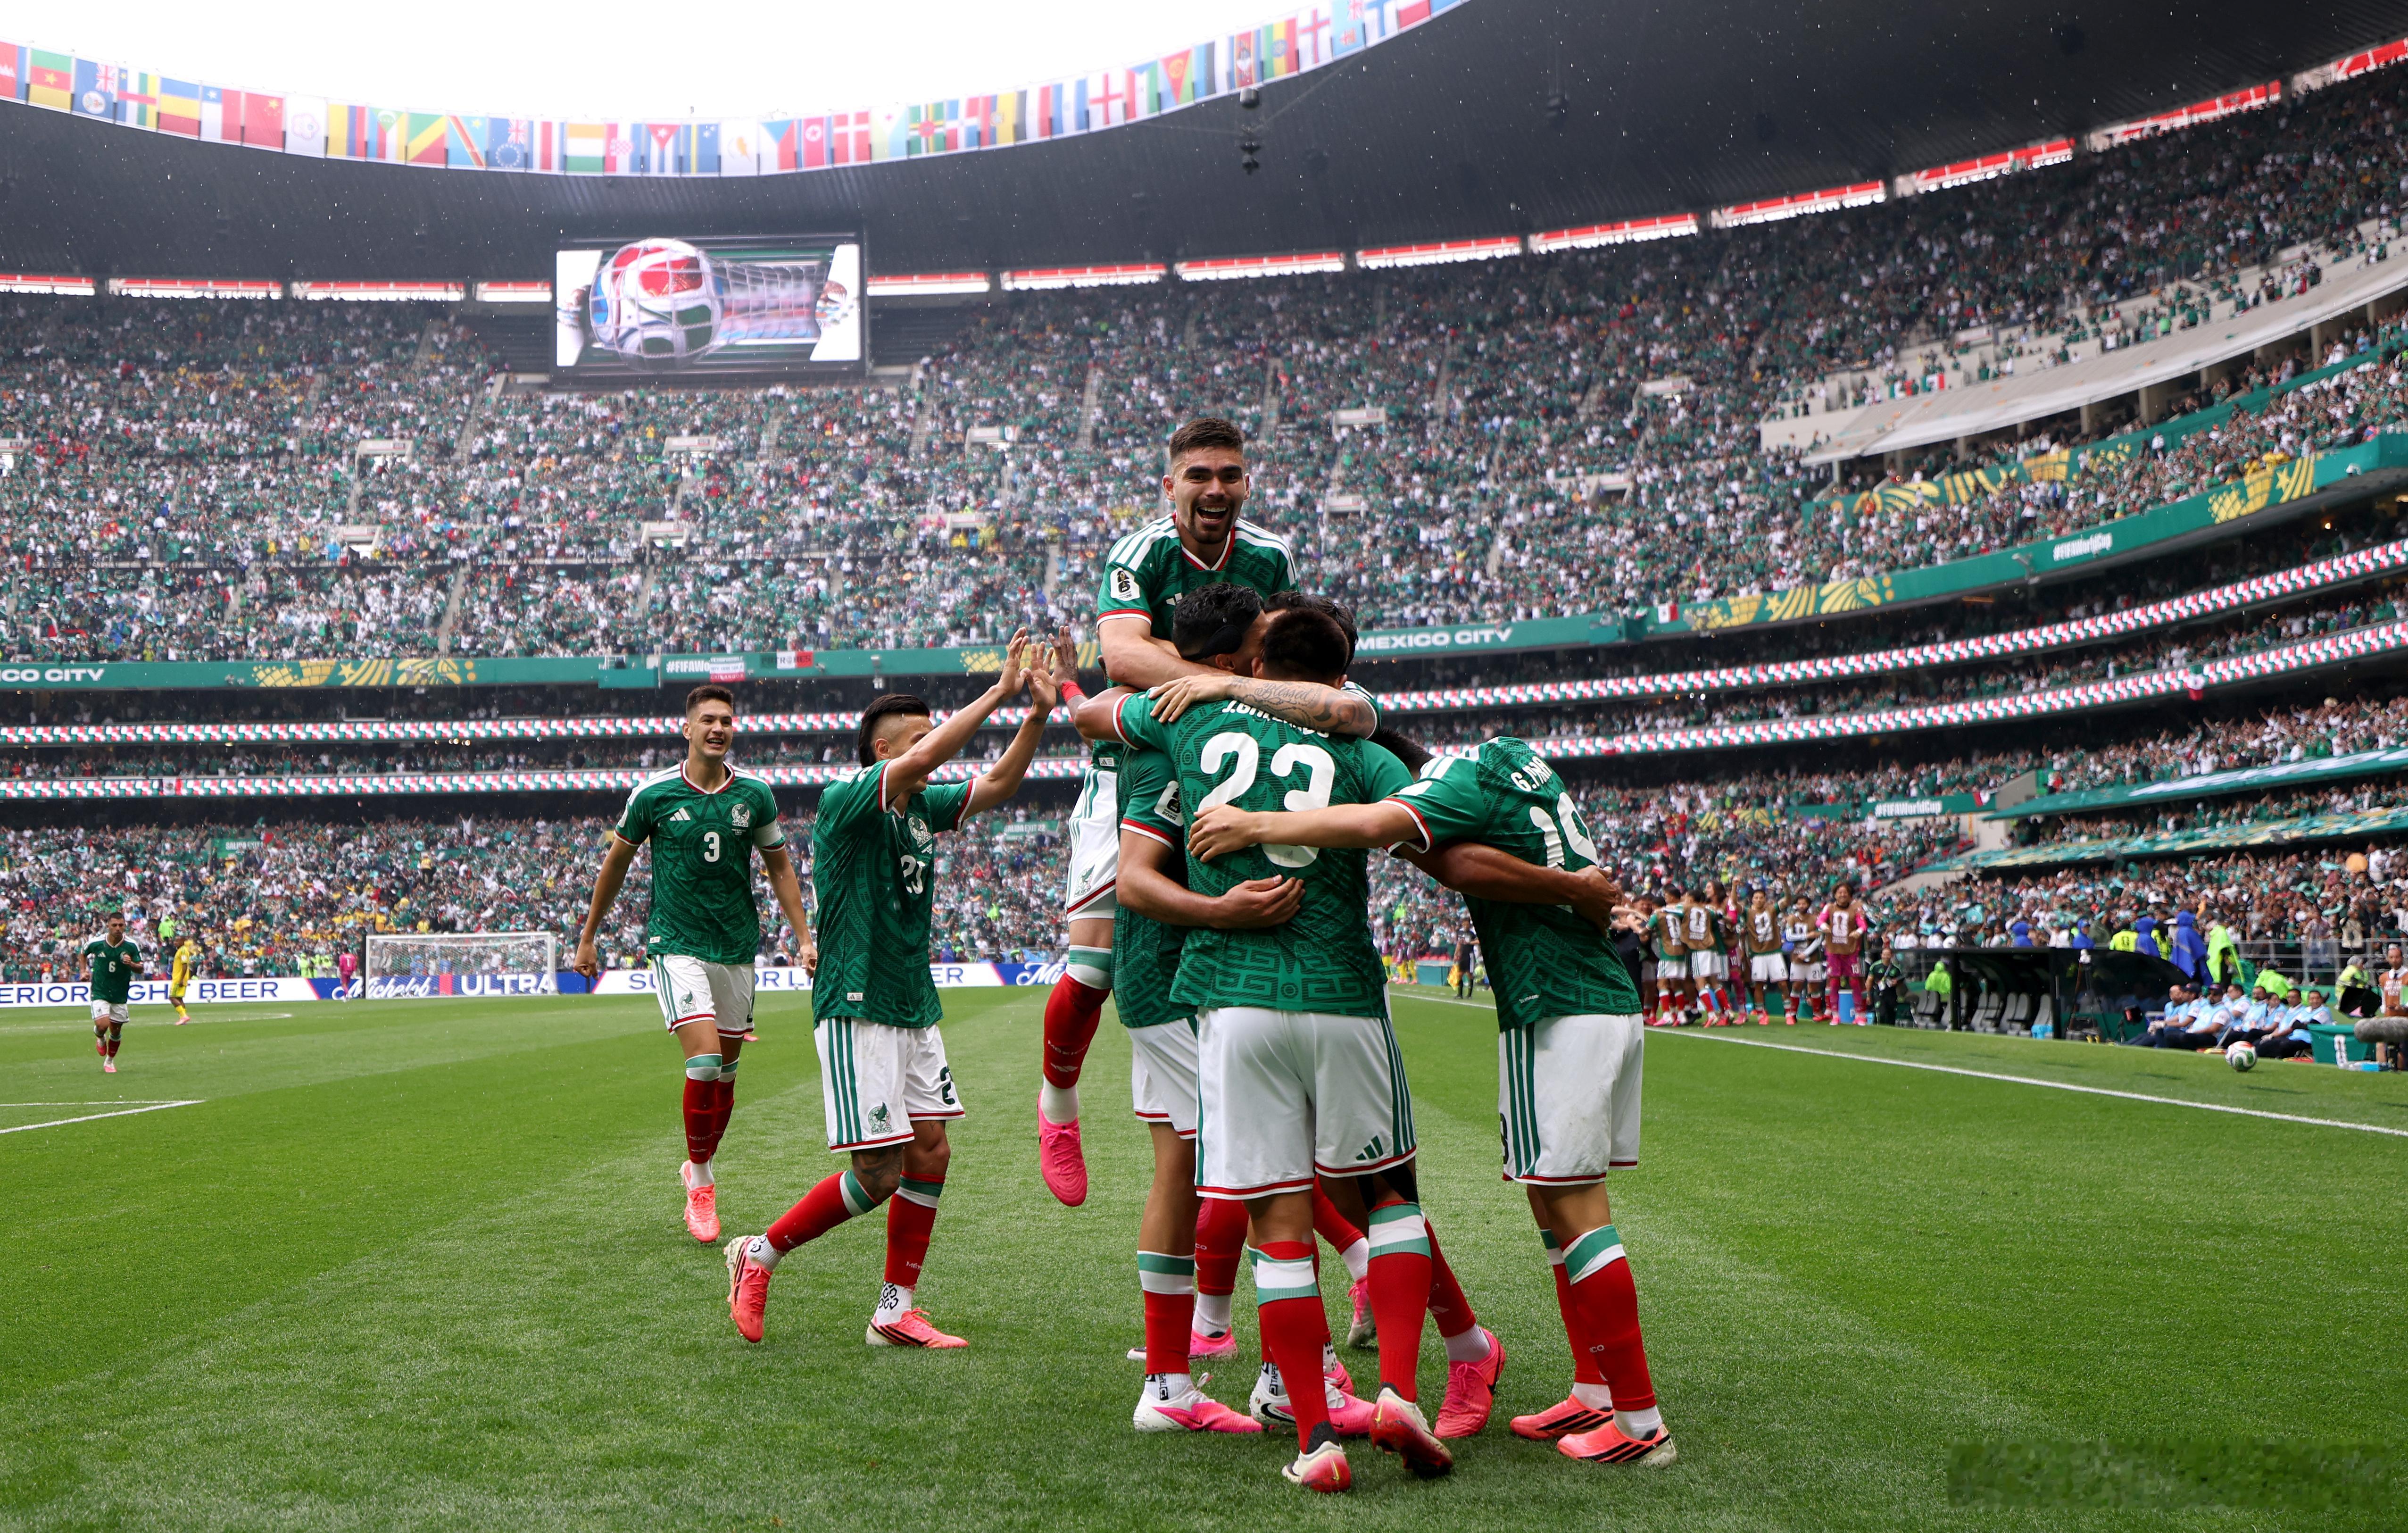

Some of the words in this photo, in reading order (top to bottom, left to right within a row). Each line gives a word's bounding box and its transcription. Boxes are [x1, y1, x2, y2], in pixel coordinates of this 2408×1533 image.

[1355, 633, 1451, 650] MEXICO
[1454, 628, 1513, 645] CITY
[44, 668, 105, 682] CITY
[1196, 732, 1336, 868] 23
[1875, 799, 1943, 817] #FIFAWorldCup
[704, 832, 720, 862] 3
[108, 961, 116, 973] 6
[347, 958, 350, 967] 1
[199, 982, 279, 1000] BEER
[332, 975, 431, 1000] Michelob
[461, 974, 556, 995] ULTRA
